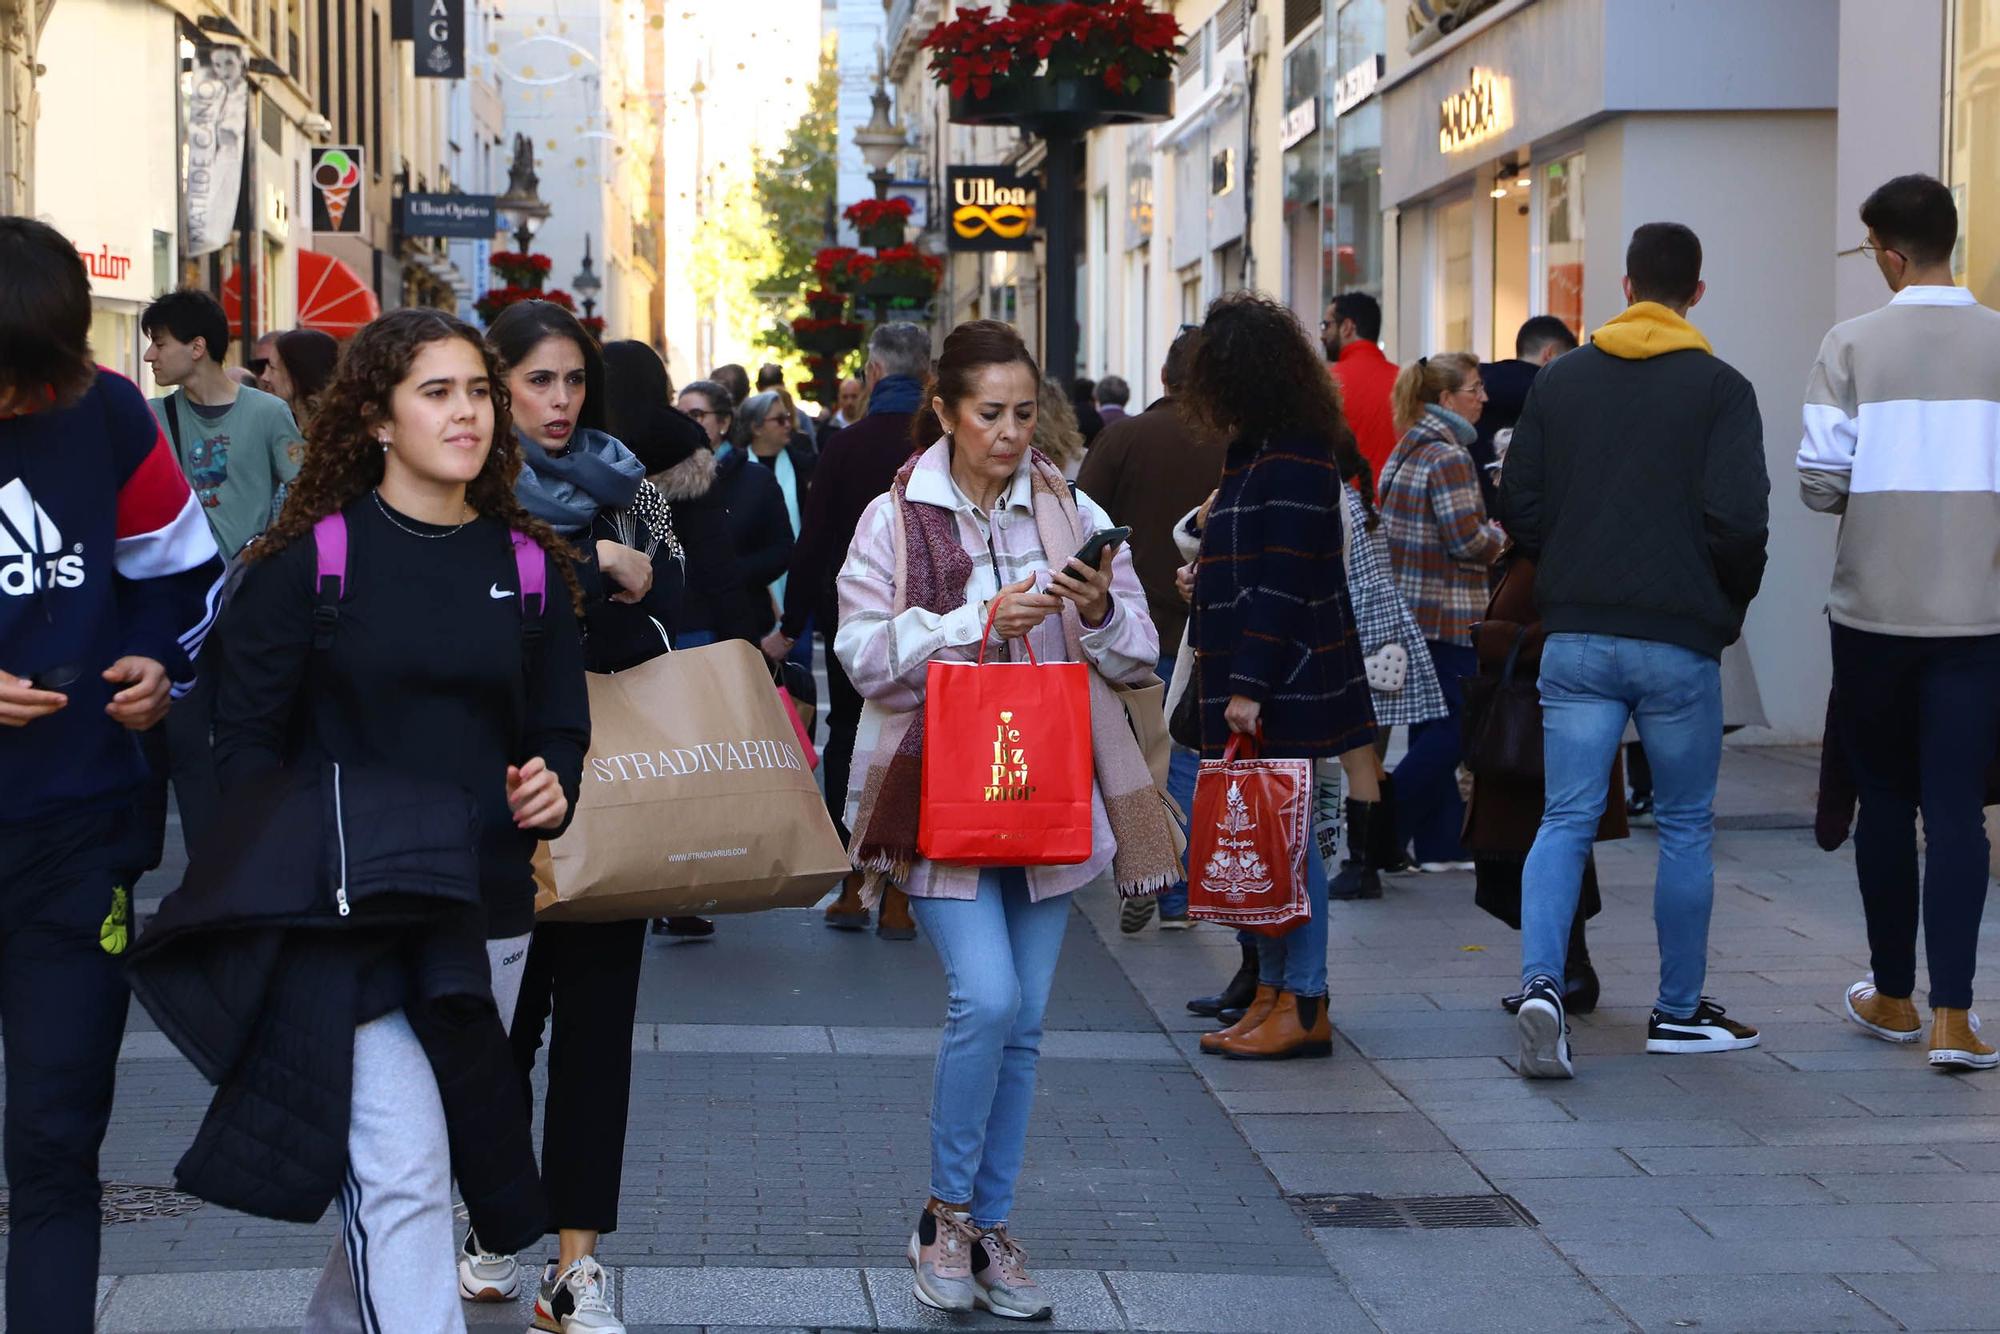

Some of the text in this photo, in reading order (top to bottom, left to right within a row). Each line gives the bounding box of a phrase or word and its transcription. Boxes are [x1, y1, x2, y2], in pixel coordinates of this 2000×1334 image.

[190, 78, 216, 245] MATILDE CANO
[954, 177, 1026, 206] Ulloa
[591, 739, 801, 783] STRADIVARIUS
[990, 763, 1028, 786] Pri
[984, 785, 1036, 802] mor
[667, 847, 748, 863] WWW.STRADIVARIUS.COM
